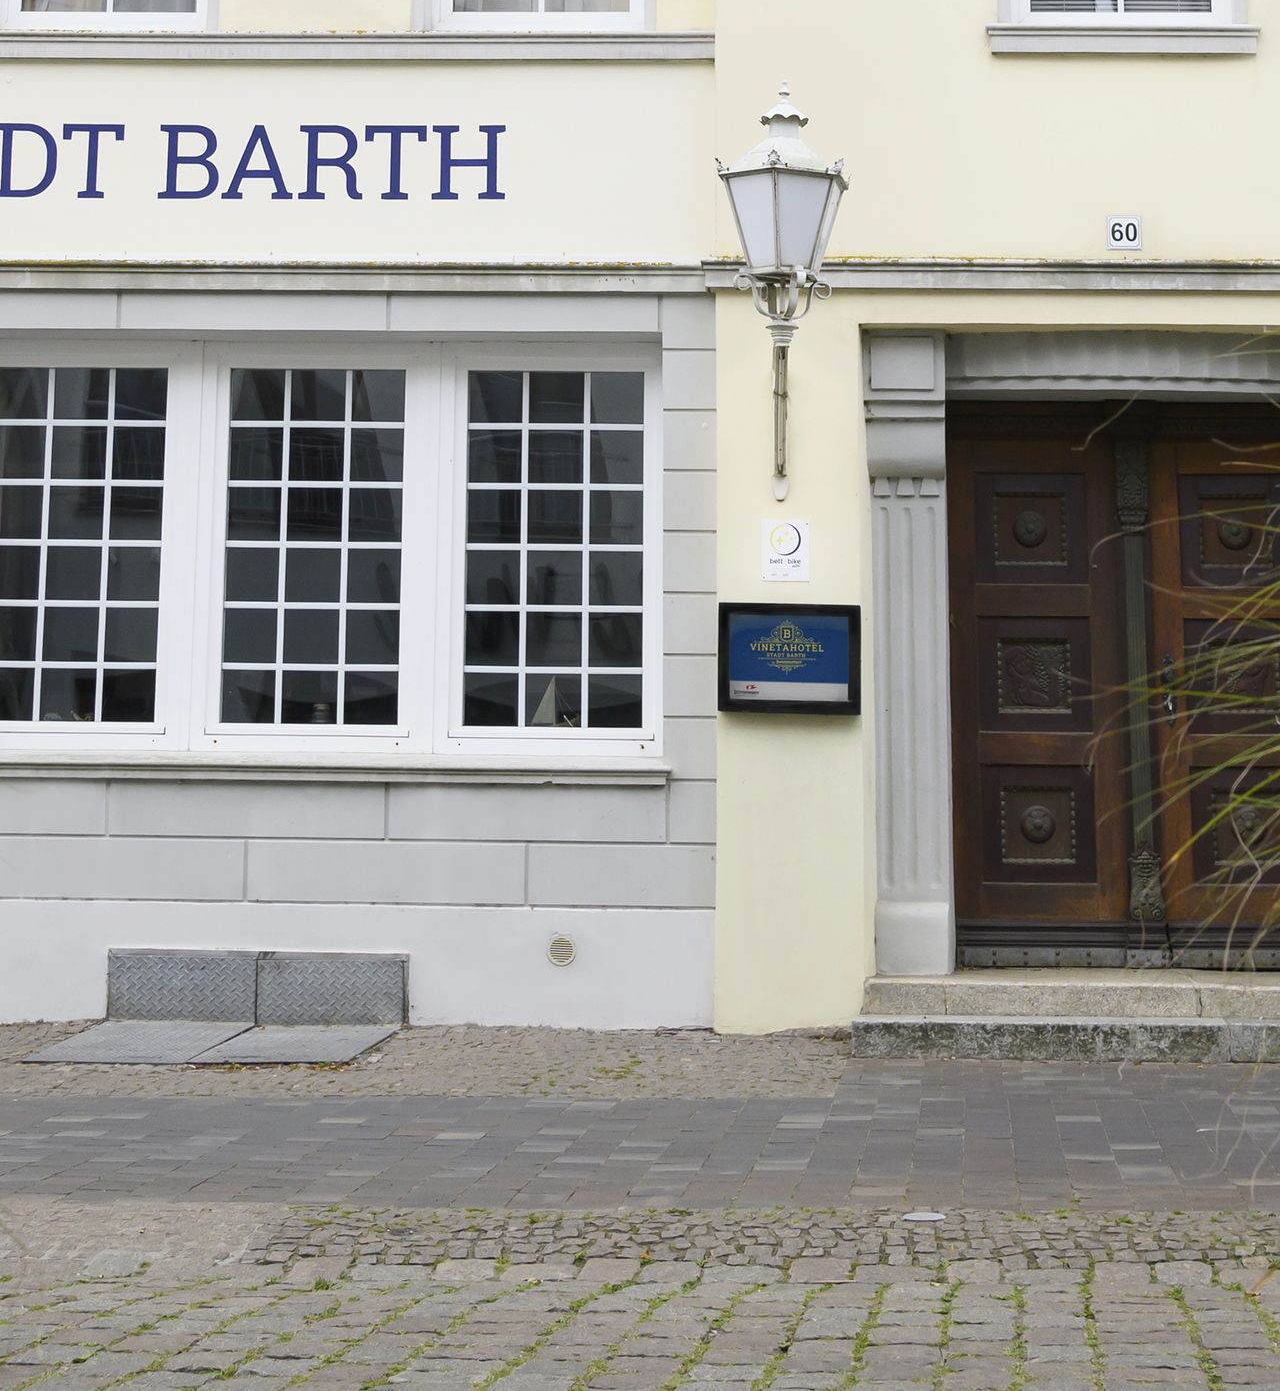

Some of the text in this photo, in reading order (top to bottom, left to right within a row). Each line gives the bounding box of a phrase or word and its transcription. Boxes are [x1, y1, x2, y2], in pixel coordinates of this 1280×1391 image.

[157, 124, 507, 200] BARTH
[1111, 222, 1138, 242] 60
[783, 629, 791, 639] B
[750, 643, 825, 653] VINETAHOTEL
